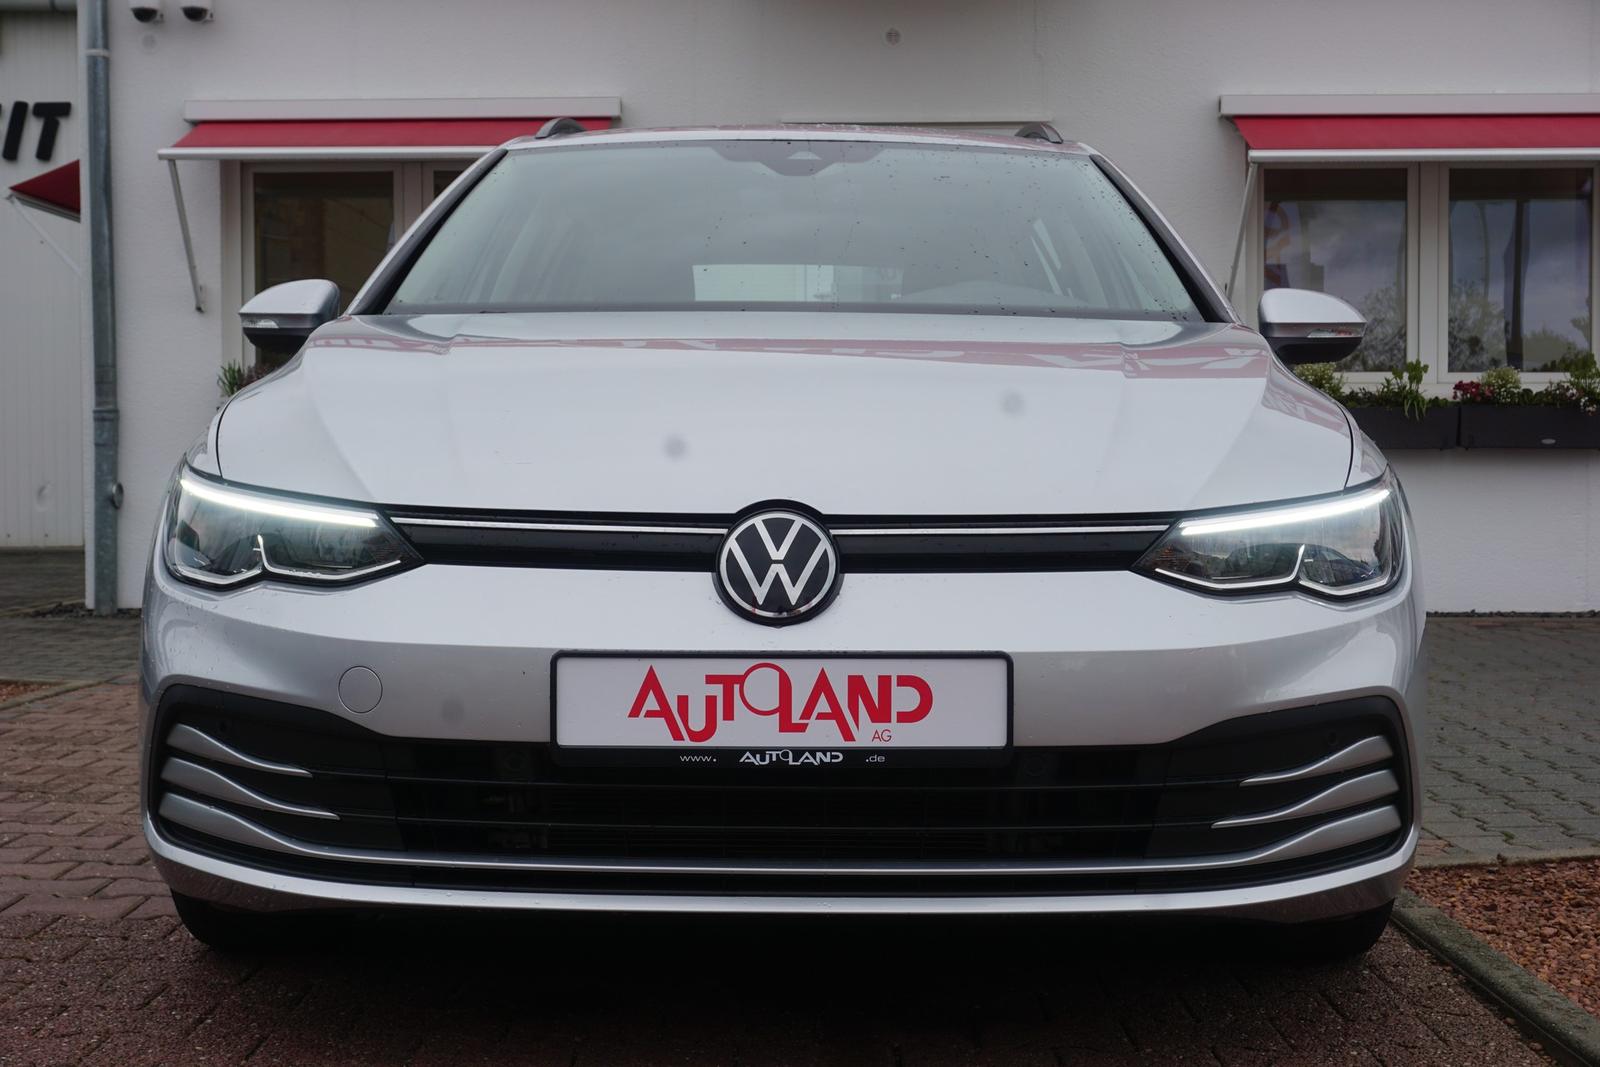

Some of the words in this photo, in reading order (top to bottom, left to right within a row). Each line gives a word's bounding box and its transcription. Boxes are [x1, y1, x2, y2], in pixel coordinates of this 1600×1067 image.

[0, 101, 72, 161] IT
[725, 515, 830, 607] VW
[628, 662, 934, 742] AUTOLAND
[739, 749, 844, 766] AUTOLAND
[871, 728, 892, 742] AG
